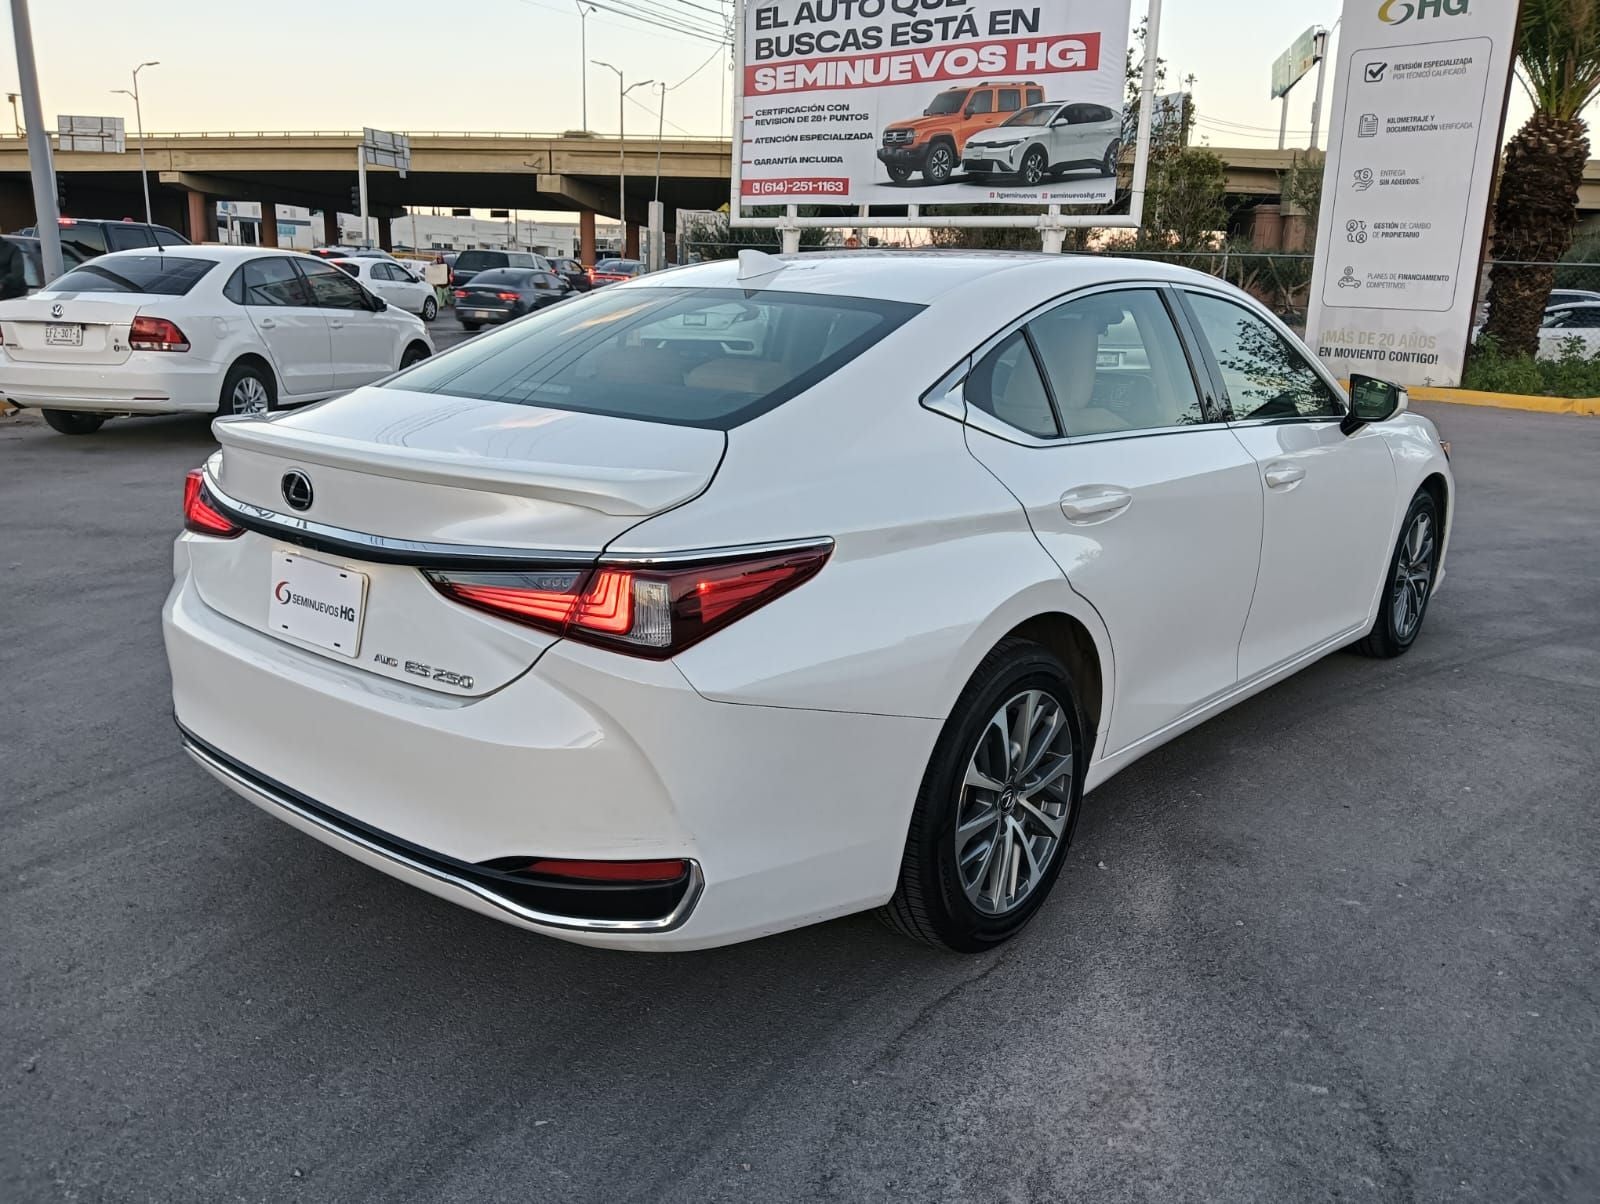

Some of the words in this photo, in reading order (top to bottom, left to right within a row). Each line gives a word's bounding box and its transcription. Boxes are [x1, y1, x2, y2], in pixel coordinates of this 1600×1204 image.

[756, 6, 788, 31] EL
[793, 0, 885, 25] AUTO
[756, 26, 883, 60] BUSCAS
[890, 7, 979, 47] ESTÁ
[988, 8, 1041, 35] EN
[754, 45, 1007, 92] SEMINUEVOS
[1015, 39, 1087, 71] HG
[1394, 61, 1422, 71] REVISIÓN
[1423, 57, 1473, 69] ESPECIALIZADA
[1392, 72, 1405, 80] POR
[1431, 67, 1467, 77] CALIFICADO
[755, 104, 825, 116] CERTIFICACIÓN
[826, 104, 850, 112] CON
[829, 113, 869, 122] PUNTOS
[1387, 115, 1429, 124] KILOMETRAJE
[1386, 124, 1438, 133] DOCUMENTACIÓN
[754, 134, 798, 144] ATENCIÓN
[799, 132, 874, 141] ESPECIALIZADA
[753, 156, 798, 166] GARANTÍA
[799, 156, 843, 164] INCLUIDA
[1380, 169, 1406, 177] ENTREGA
[761, 180, 844, 193] (614)-251-1163
[1050, 192, 1106, 200] seminuevoshg.mx
[1373, 221, 1399, 229] GESTIÓN
[1398, 273, 1450, 281] FINANCIAMIENTO
[1321, 328, 1354, 345] ¡MÁS
[1358, 331, 1376, 346] DE
[1379, 332, 1395, 347] 20
[1398, 331, 1437, 349] AÑOS
[1318, 347, 1332, 357] EN
[1334, 347, 1386, 360] MOVIENTO
[1388, 351, 1439, 365] CONTIGO!
[292, 594, 339, 618] SEMINUEVOS
[339, 604, 355, 622] HG
[374, 653, 398, 668] AWD
[404, 660, 431, 678] ES
[432, 667, 474, 689] 250
